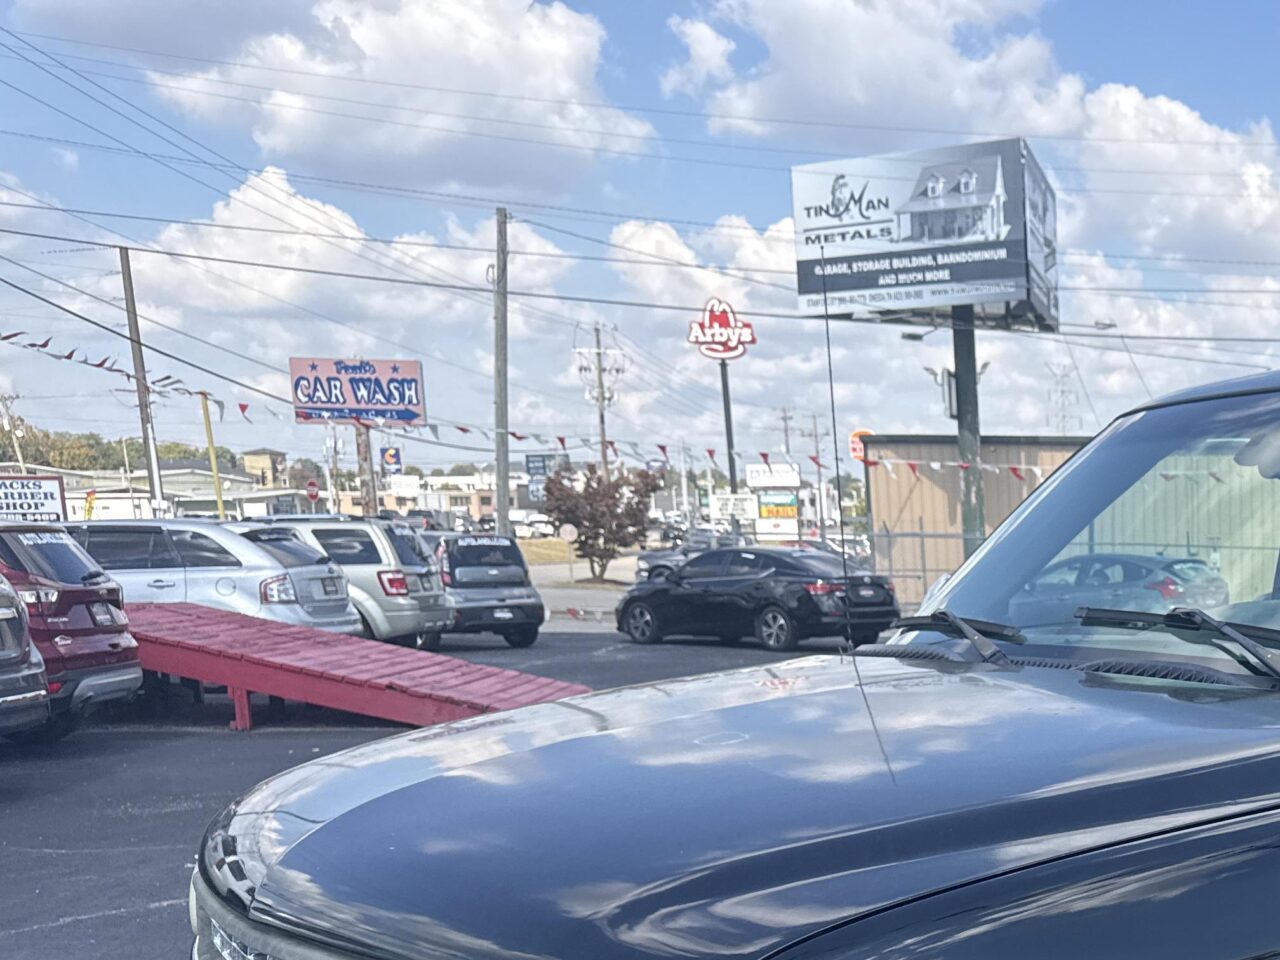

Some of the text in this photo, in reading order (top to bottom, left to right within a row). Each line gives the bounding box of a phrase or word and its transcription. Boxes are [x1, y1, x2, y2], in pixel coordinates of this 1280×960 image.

[805, 227, 892, 245] METALS
[852, 257, 891, 273] STORAGE
[937, 247, 1007, 265] BARNDOMINIUM
[878, 269, 951, 286] AND MUCH MORE
[689, 321, 753, 347] Arby's
[295, 377, 419, 405] CAR WASH
[0, 492, 57, 500] RBER
